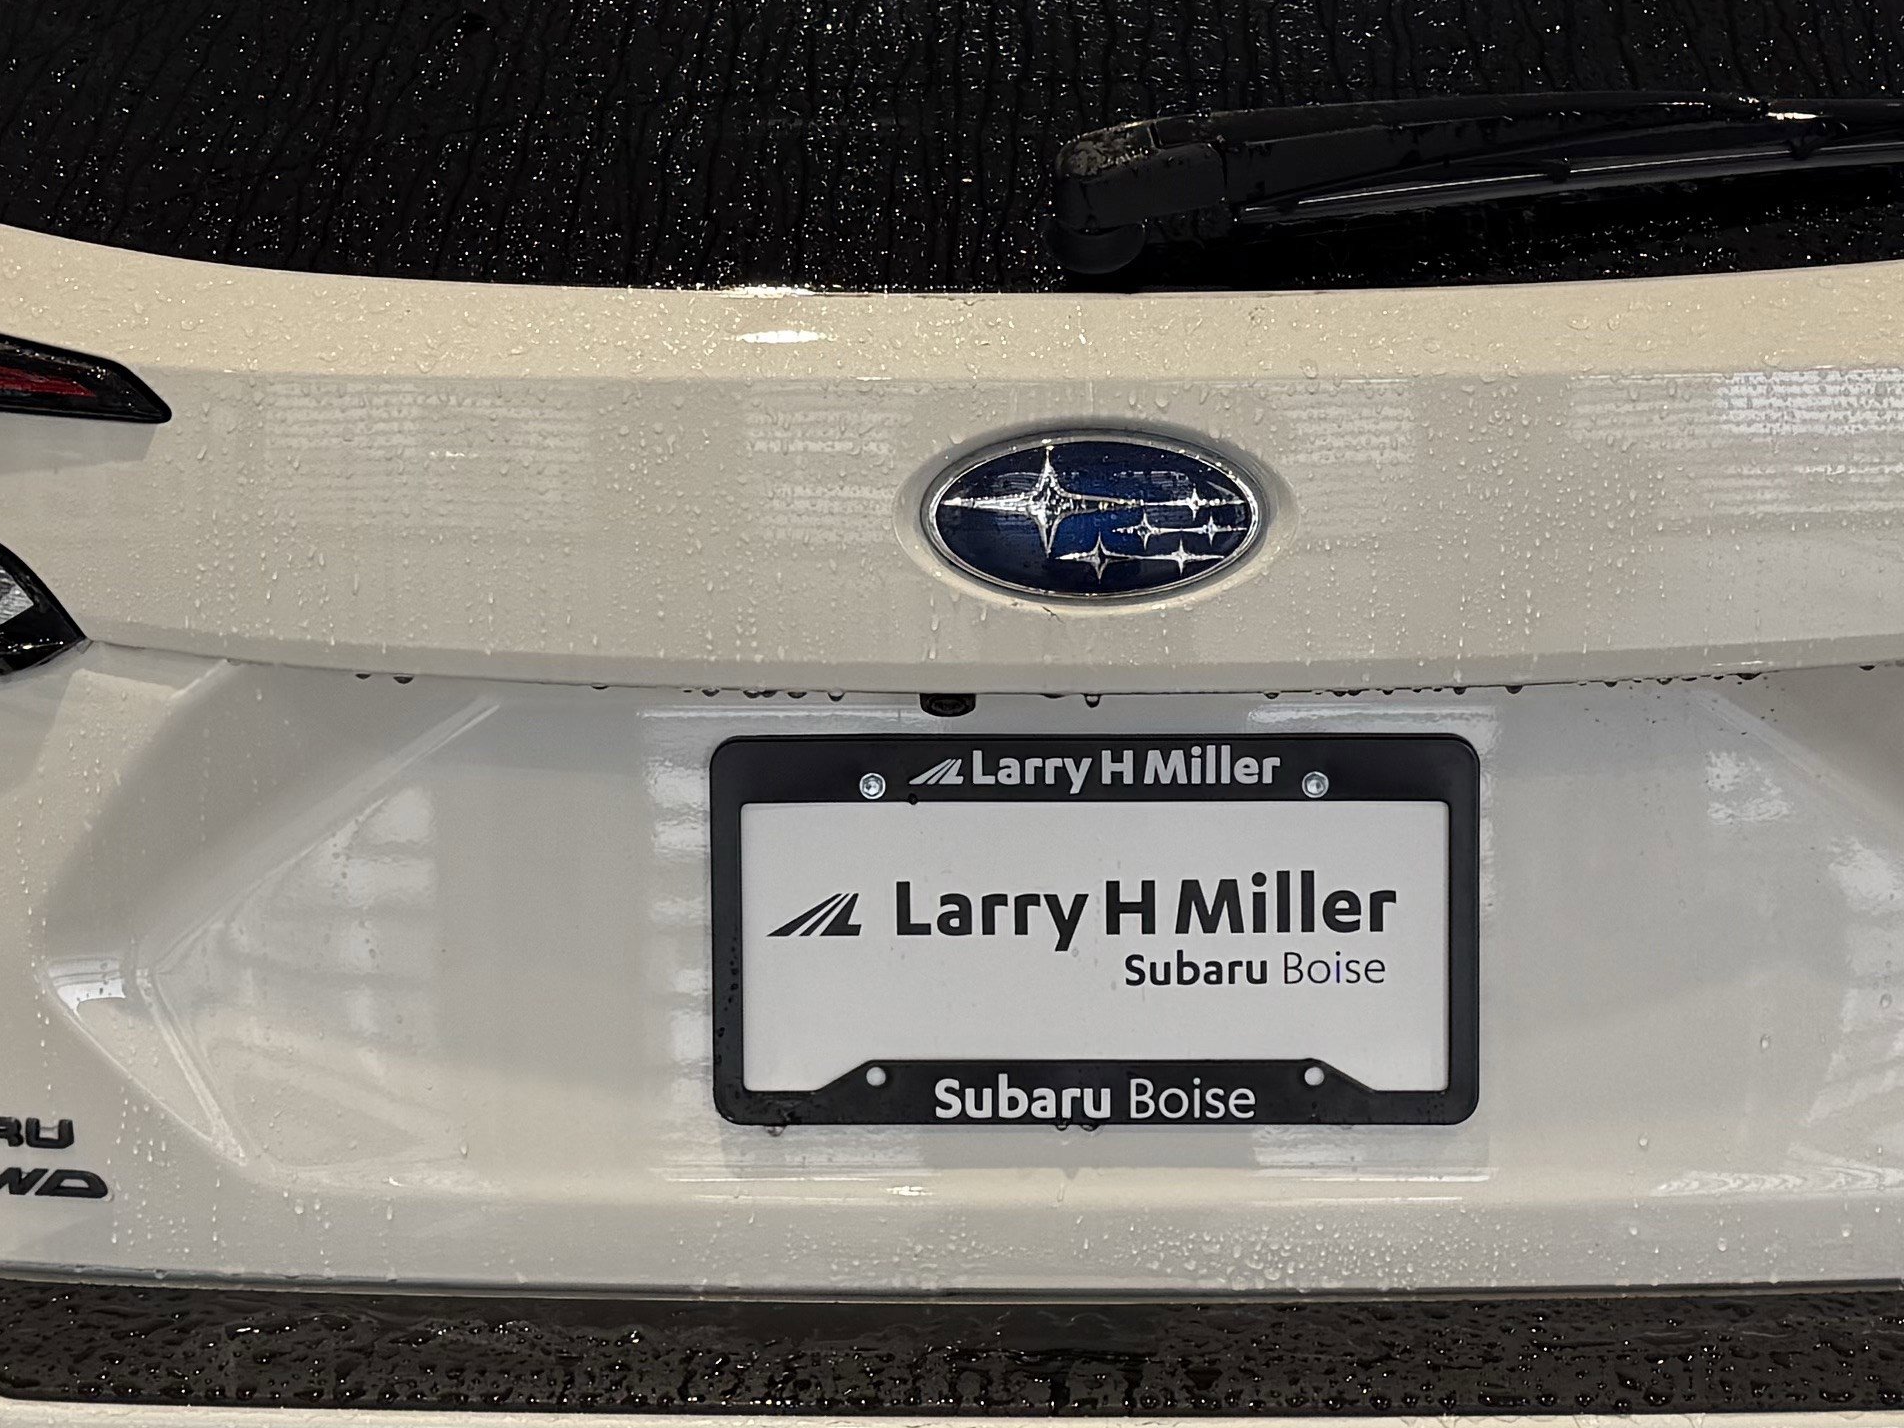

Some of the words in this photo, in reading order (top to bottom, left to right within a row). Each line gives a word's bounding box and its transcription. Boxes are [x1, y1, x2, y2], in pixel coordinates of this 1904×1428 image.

[971, 750, 1089, 794] Larry
[1101, 751, 1139, 784] H
[1144, 744, 1281, 786] Miller
[895, 880, 1089, 952] Larry
[1105, 880, 1156, 935] H
[1175, 870, 1397, 935] Miller
[1124, 950, 1268, 987] Subaru
[1283, 951, 1387, 985] Boise
[934, 1073, 1112, 1120] Subaru
[1129, 1077, 1256, 1120] Boise
